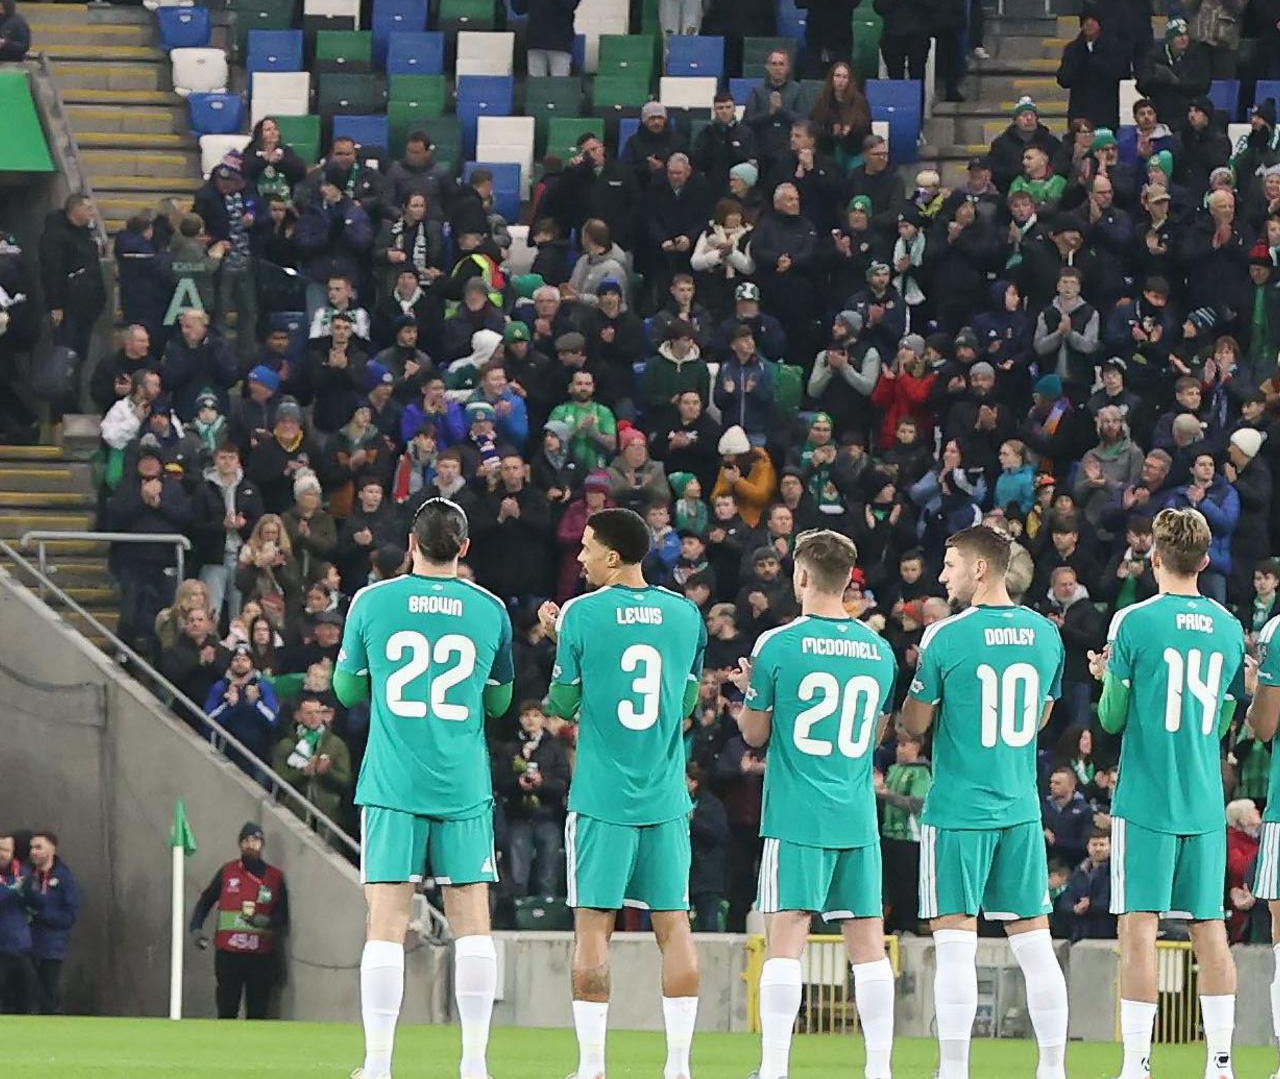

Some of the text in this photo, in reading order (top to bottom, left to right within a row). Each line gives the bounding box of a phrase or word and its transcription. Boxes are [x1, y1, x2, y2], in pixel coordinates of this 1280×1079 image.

[162, 278, 205, 326] A
[408, 595, 463, 617] BROWN
[616, 607, 663, 625] LEWIS
[1175, 613, 1214, 634] PRICE
[802, 637, 882, 661] MCDONNELL
[984, 628, 1036, 646] DONLEY
[385, 630, 477, 721] 22
[617, 643, 662, 731] 3
[1163, 647, 1224, 736] 14
[792, 671, 880, 758] 20
[976, 662, 1040, 749] 10
